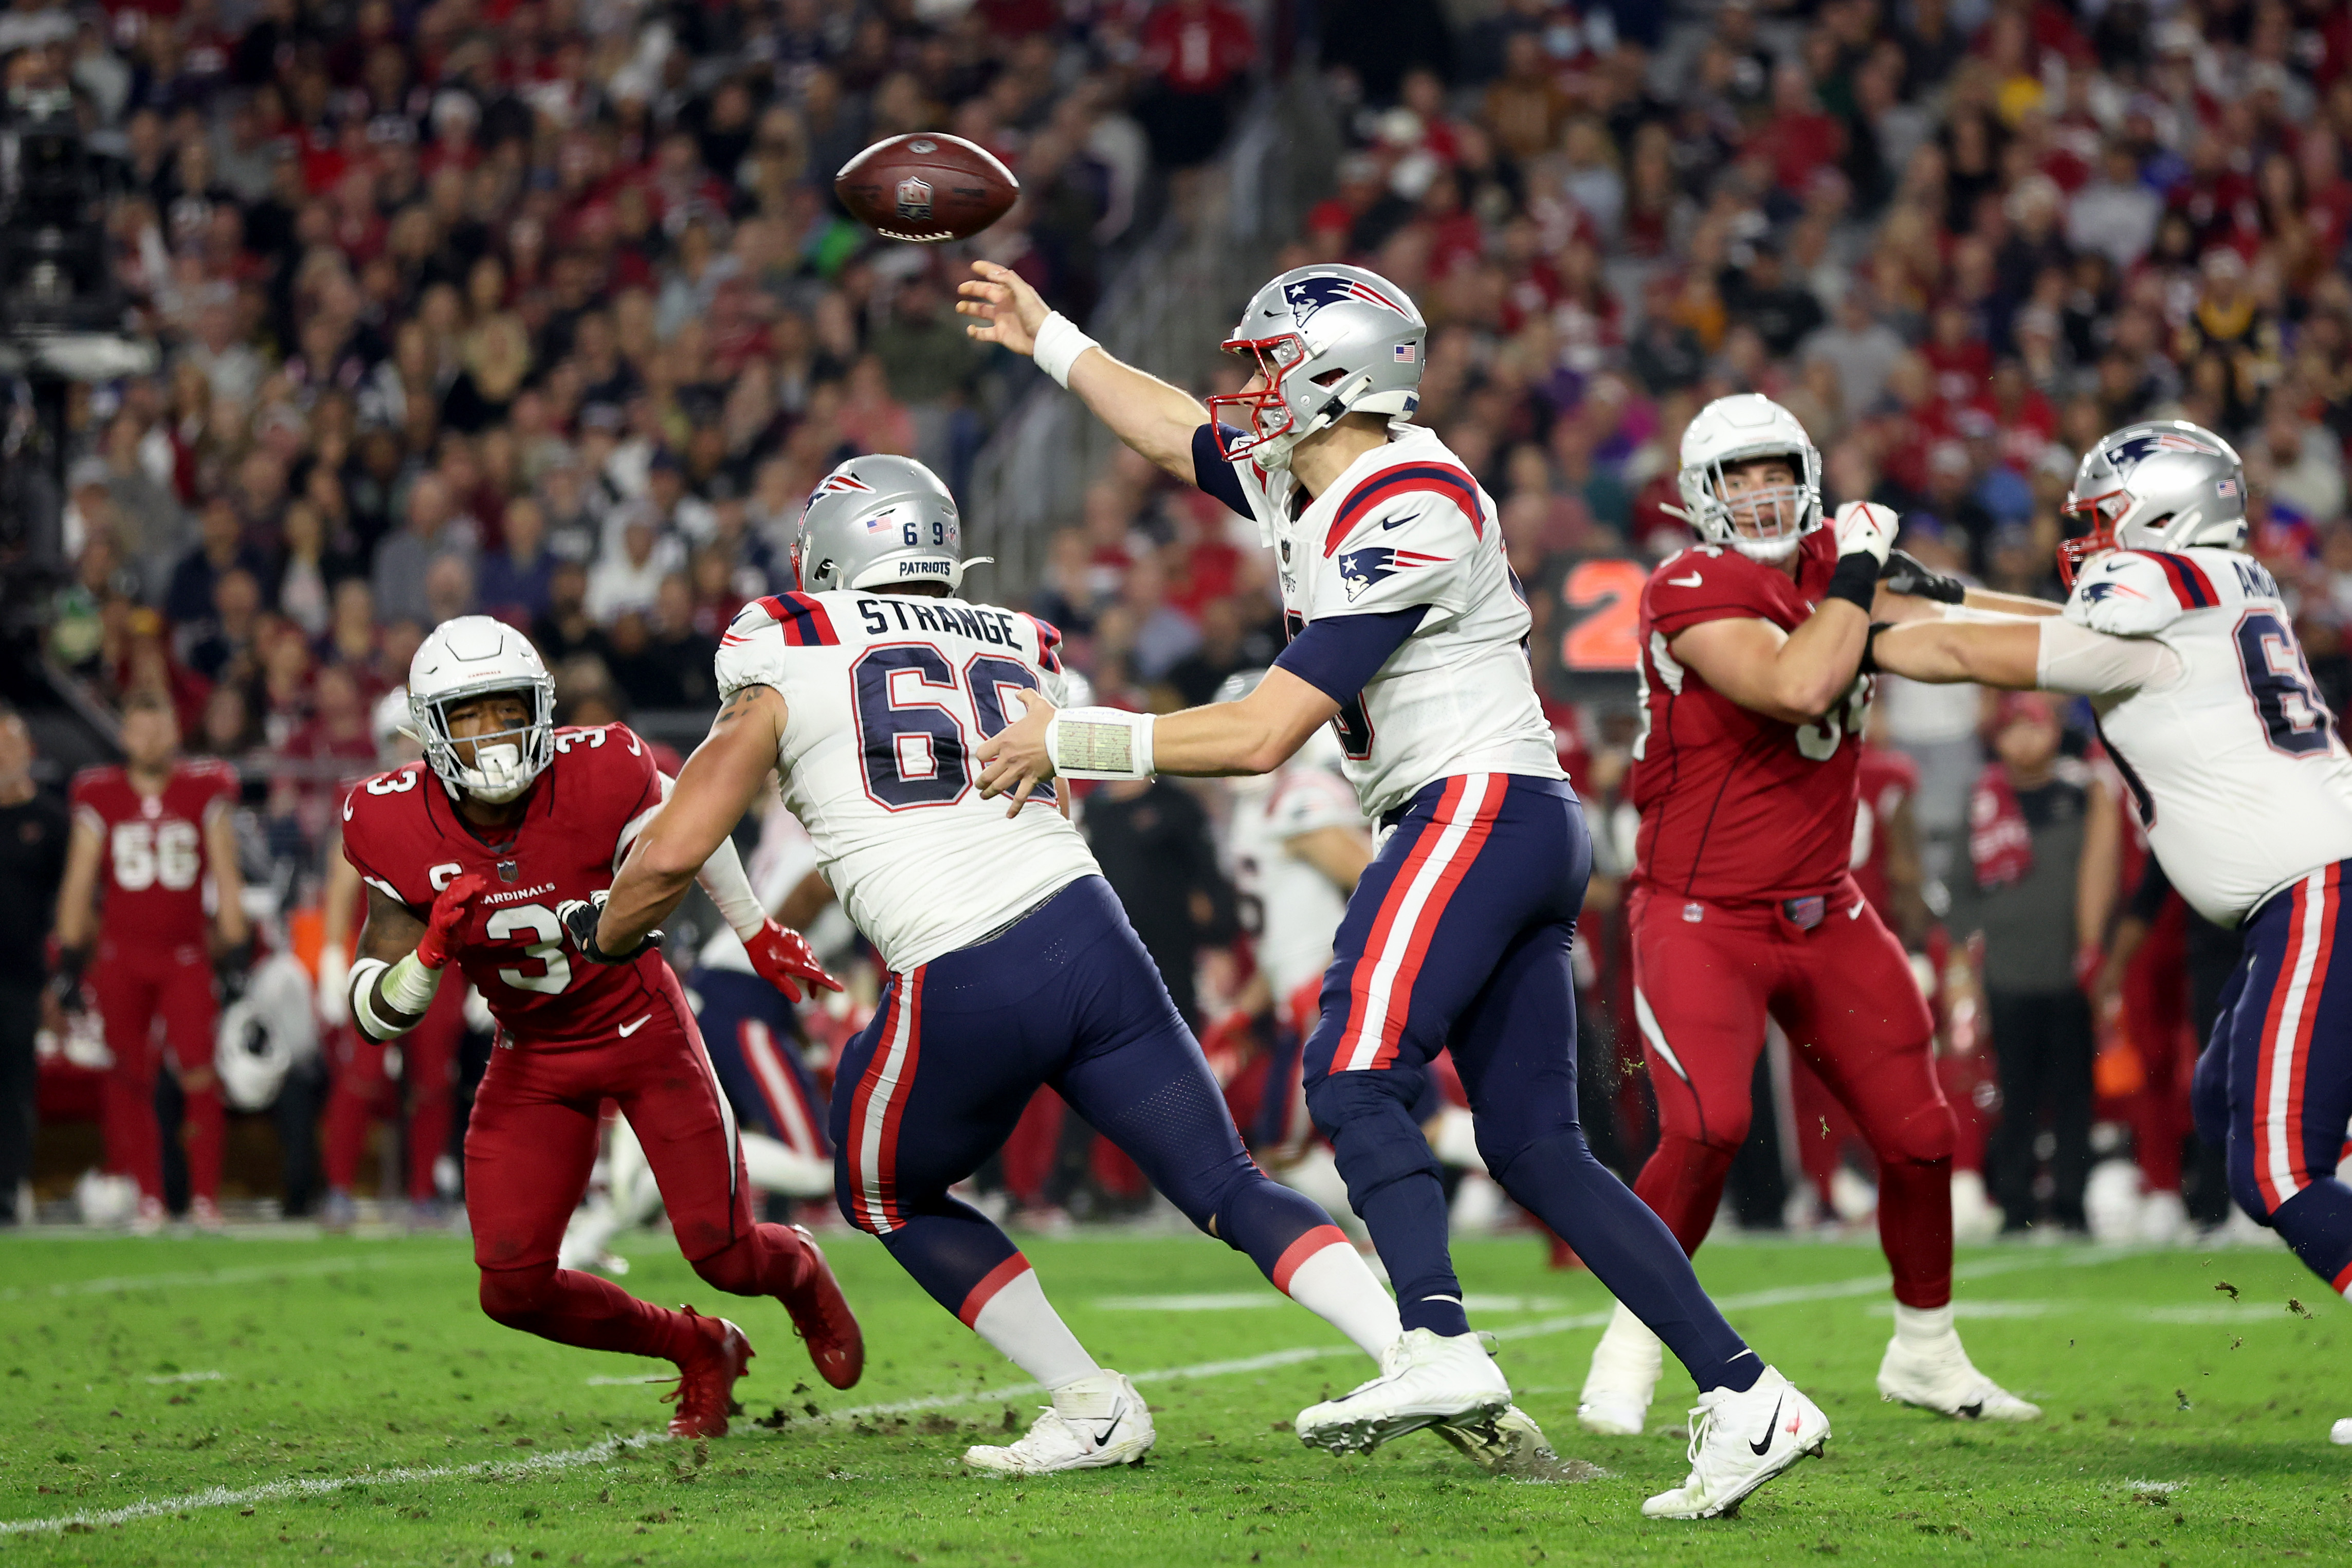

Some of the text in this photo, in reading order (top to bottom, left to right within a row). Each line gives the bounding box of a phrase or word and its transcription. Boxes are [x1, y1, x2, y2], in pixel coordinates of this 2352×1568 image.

[900, 561, 950, 577] PATRIOTS
[858, 599, 1023, 651] STRANGE
[1563, 559, 1649, 670] 2
[555, 728, 607, 754] 3
[367, 771, 417, 795] 3
[111, 820, 200, 891] 56
[480, 882, 556, 904] ARDINALS
[486, 903, 572, 995] 3
